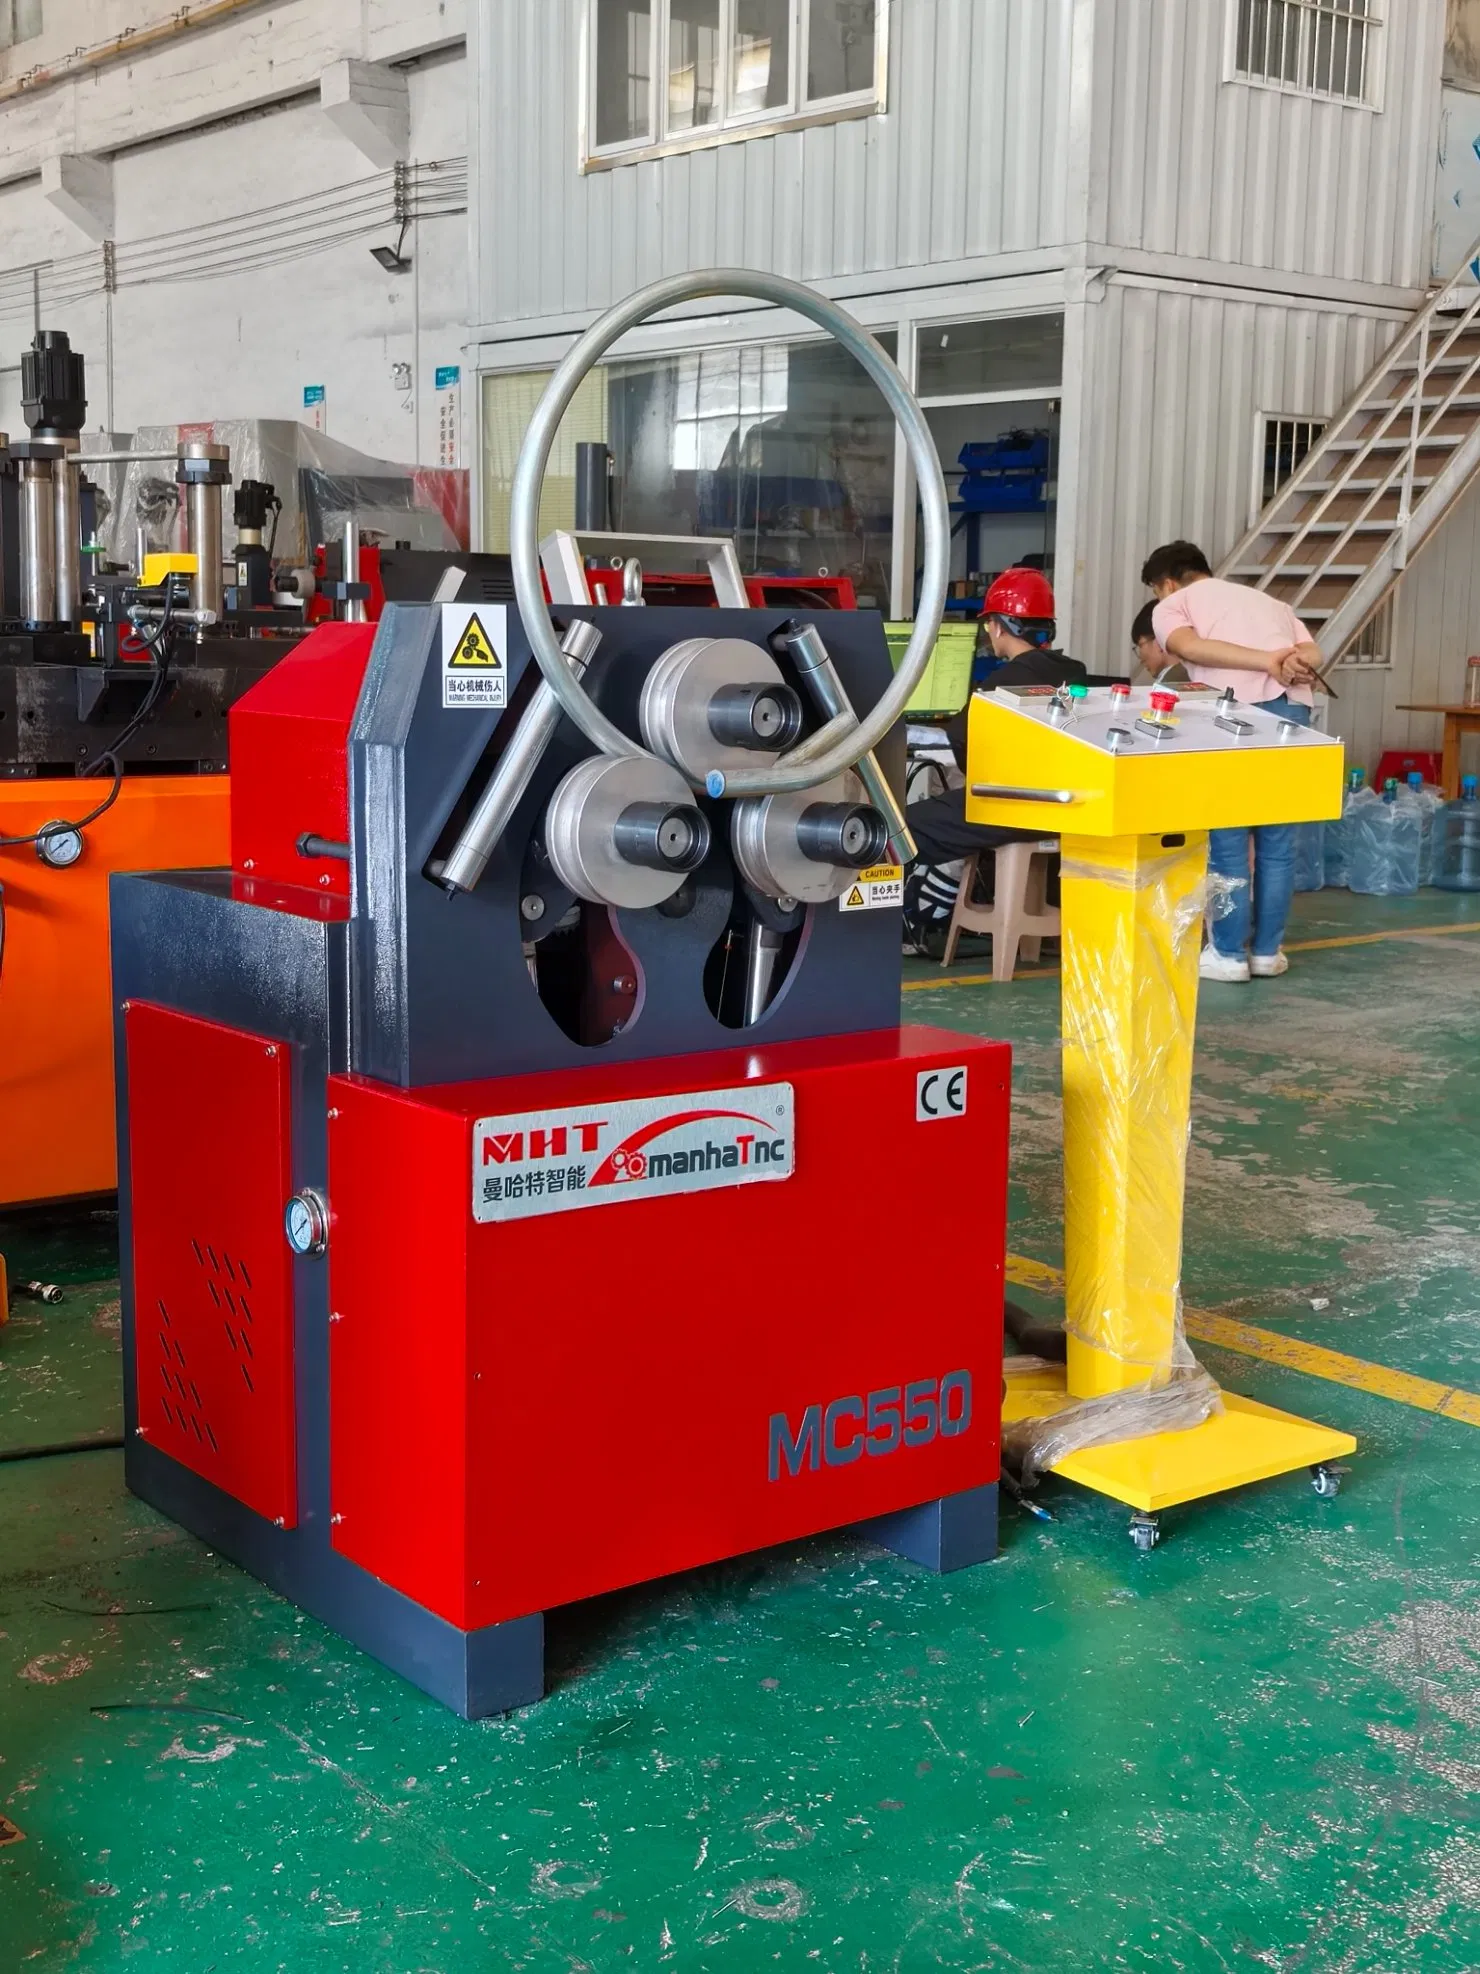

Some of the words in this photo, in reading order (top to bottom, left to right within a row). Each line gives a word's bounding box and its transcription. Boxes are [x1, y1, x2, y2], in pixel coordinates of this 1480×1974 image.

[448, 679, 502, 692] 当心机械伤人
[866, 869, 894, 878] CAUTION
[872, 884, 900, 895] 当心夹手
[920, 1071, 964, 1115] CE
[483, 1120, 609, 1167] MHT
[648, 1134, 786, 1179] manhaTnc
[483, 1163, 587, 1204] 曼哈特智能
[767, 1368, 973, 1483] MC550
